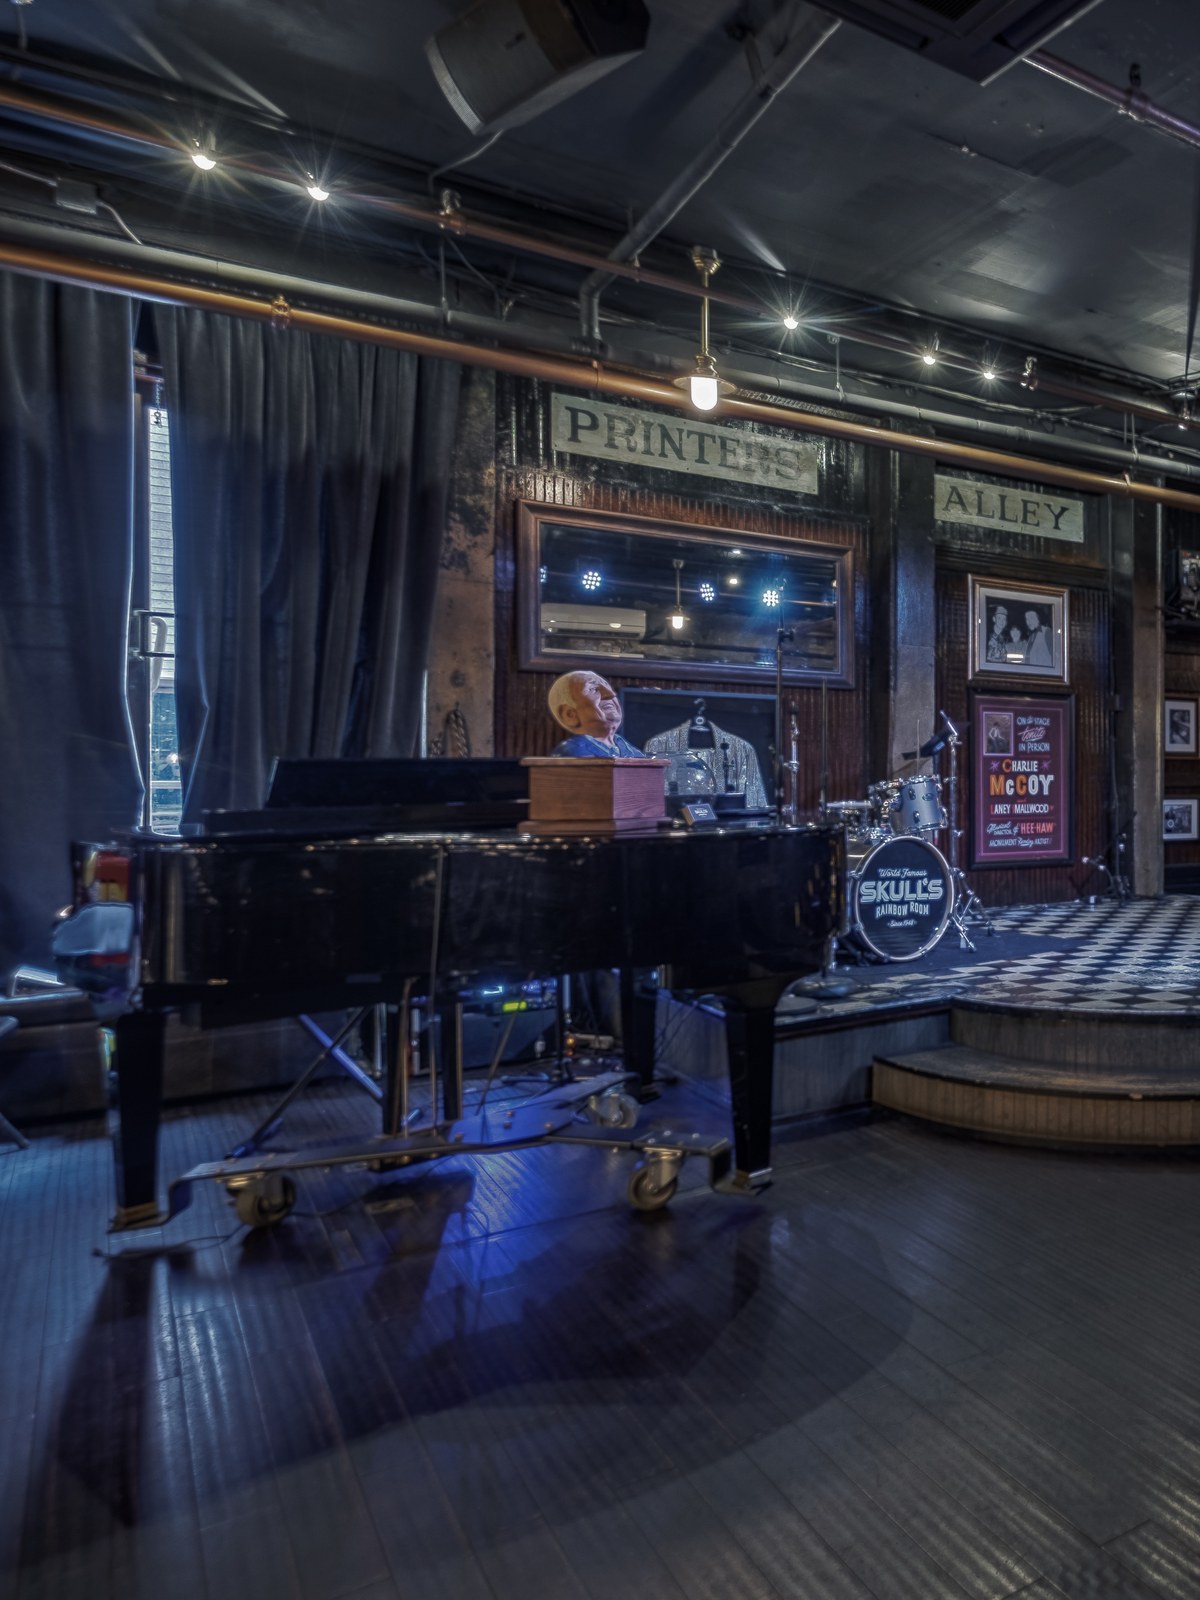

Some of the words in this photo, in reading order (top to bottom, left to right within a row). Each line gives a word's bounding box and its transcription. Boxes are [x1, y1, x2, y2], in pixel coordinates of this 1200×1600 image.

[565, 406, 803, 480] PRINTERS
[941, 485, 1070, 531] ALLEY
[1016, 717, 1026, 725] ON
[1034, 717, 1050, 726] STAGE
[1018, 743, 1026, 751] IN
[1027, 742, 1050, 753] PERSON
[1002, 759, 1038, 772] CHARLIE
[989, 774, 1054, 796] McCOY
[990, 804, 1011, 815] LANEY
[878, 868, 900, 877] World
[901, 868, 927, 878] Famous
[860, 878, 943, 903] SKULL'S
[875, 903, 908, 919] RAINBOW
[910, 901, 929, 915] ROOM
